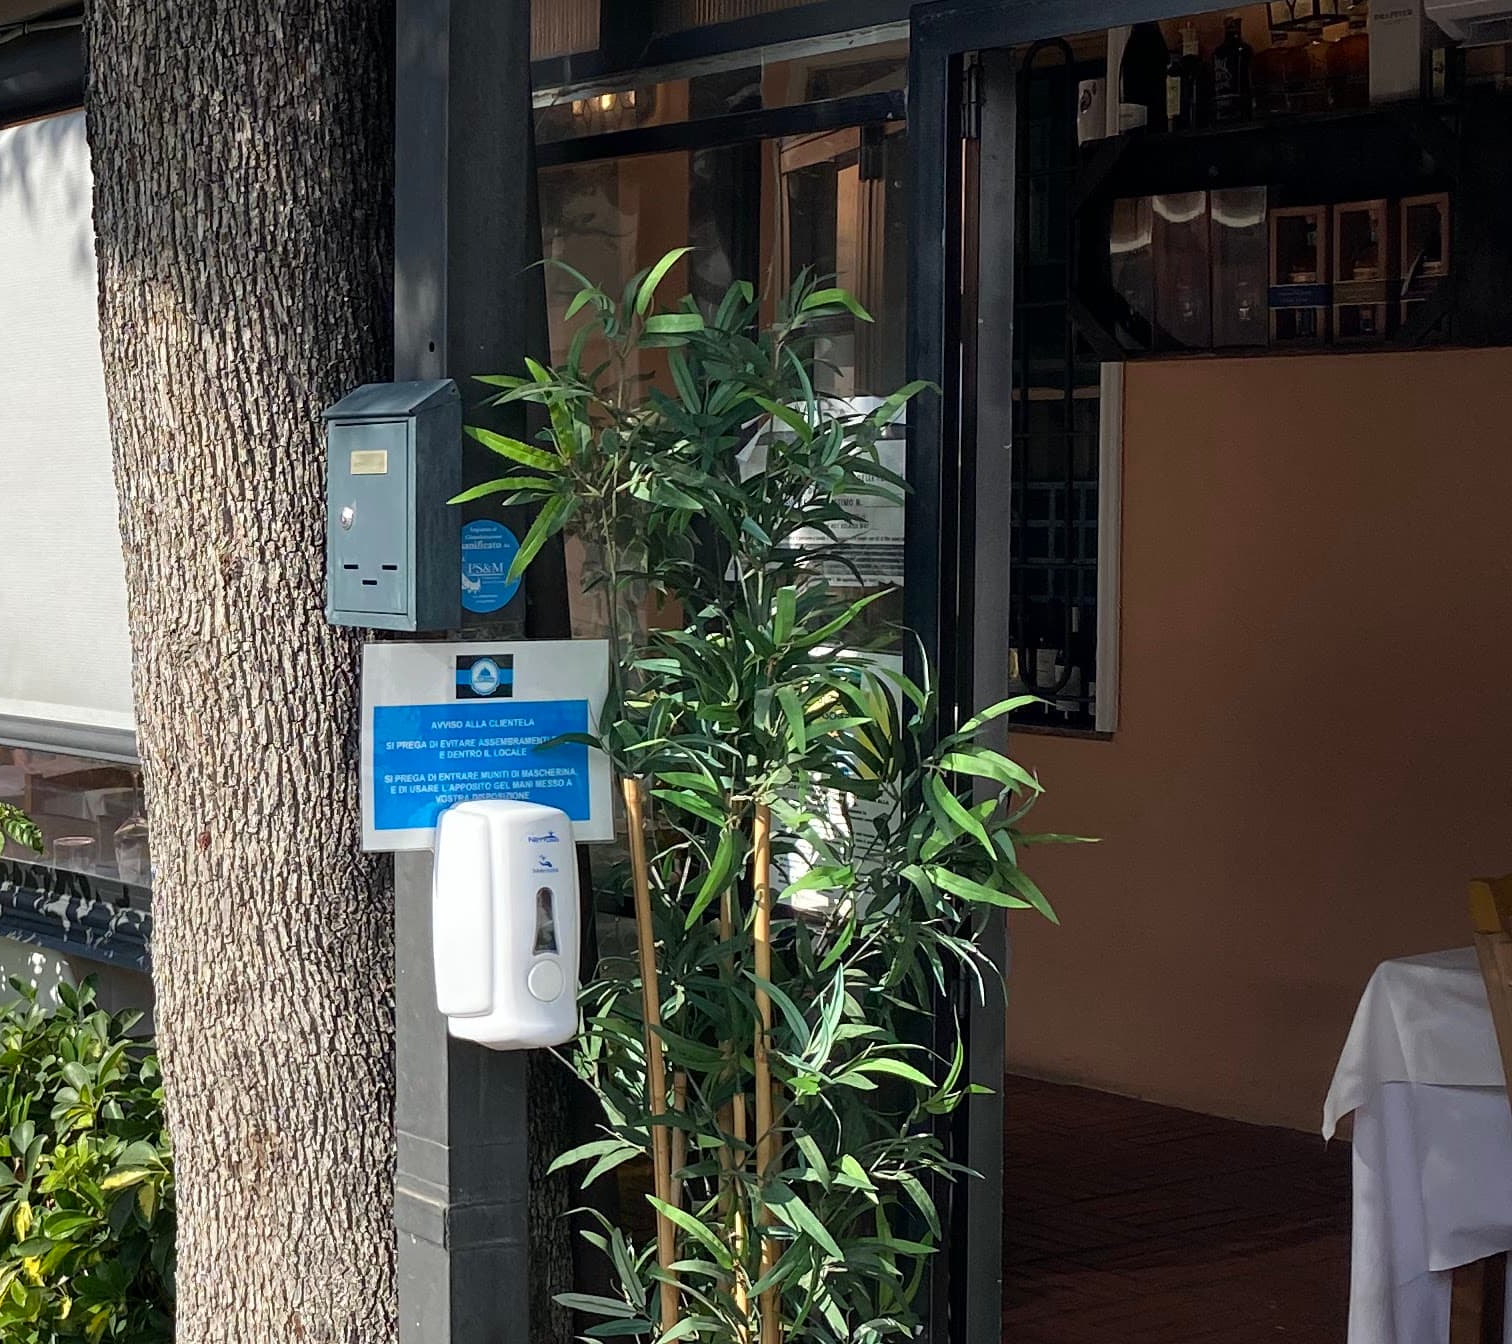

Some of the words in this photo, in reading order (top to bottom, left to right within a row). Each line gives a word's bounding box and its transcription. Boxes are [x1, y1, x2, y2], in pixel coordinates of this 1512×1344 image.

[431, 720, 463, 729] AVVISO
[465, 719, 487, 728] ALLA
[489, 718, 535, 728] CLIENTELA
[386, 741, 394, 750] SI
[396, 740, 427, 750] PREGA
[429, 740, 438, 749] DI
[440, 739, 476, 748] EVITARE
[439, 750, 445, 759] E
[447, 749, 482, 759] DENTRO
[484, 749, 492, 757] IL
[493, 747, 527, 757] LOCALE
[384, 774, 393, 784] SI
[395, 773, 426, 783] PREGA
[428, 773, 437, 782] DI
[438, 772, 479, 781] ENTRARE
[481, 770, 508, 780] MUNITI
[511, 769, 520, 778] DI
[390, 785, 396, 794] E
[398, 785, 408, 794] DI
[409, 784, 439, 793] USARE
[493, 781, 510, 790] GEL
[512, 780, 533, 789] MANI
[535, 778, 564, 788] MESSO
[566, 778, 573, 786] A
